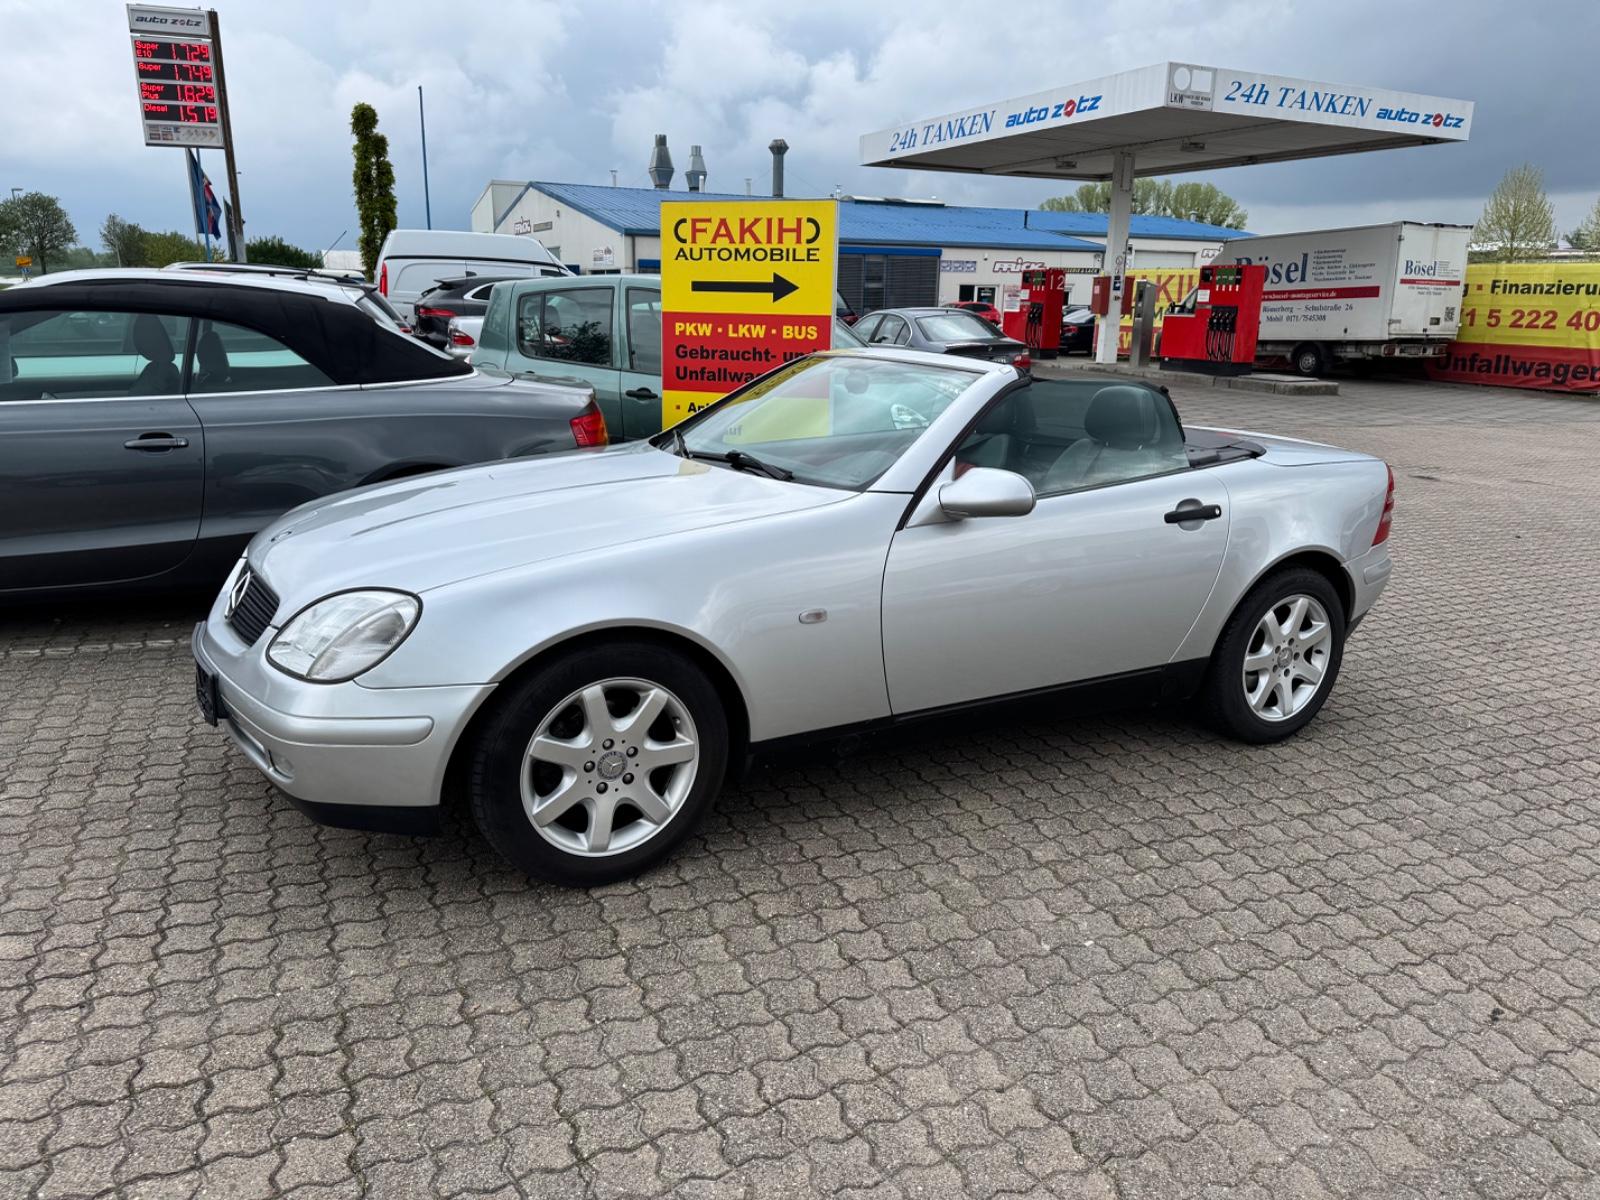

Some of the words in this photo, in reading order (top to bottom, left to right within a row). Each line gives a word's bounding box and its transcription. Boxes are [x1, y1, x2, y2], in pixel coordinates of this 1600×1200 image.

[135, 16, 168, 24] auto
[171, 18, 202, 27] zotz
[135, 41, 159, 50] Super
[171, 43, 209, 62] 1.729
[136, 50, 152, 58] E10
[139, 62, 161, 71] Super
[174, 64, 212, 81] 1.749
[141, 83, 164, 92] Super
[142, 91, 160, 99] Plus
[177, 85, 215, 103] 1.829
[1170, 92, 1184, 104] LKW
[1225, 80, 1270, 105] 24h
[1277, 86, 1373, 117] TANKEN
[1376, 107, 1419, 123] auto
[1421, 112, 1465, 129] zotz
[144, 103, 168, 112] Diesel
[180, 105, 218, 122] 1.519
[889, 132, 917, 152] 24h
[921, 110, 996, 146] TANKEN
[1005, 107, 1048, 128] auto
[1051, 95, 1103, 119] zotz
[690, 217, 803, 245] FAKIH
[674, 247, 820, 262] AUTOMOBILE
[1405, 260, 1437, 276] Bösel
[1487, 308, 1502, 328] 5
[1509, 309, 1559, 330] 222
[675, 322, 712, 337] PKW
[728, 324, 766, 338] LKW
[782, 325, 818, 340] BUS
[675, 344, 776, 362] Gebraucht-
